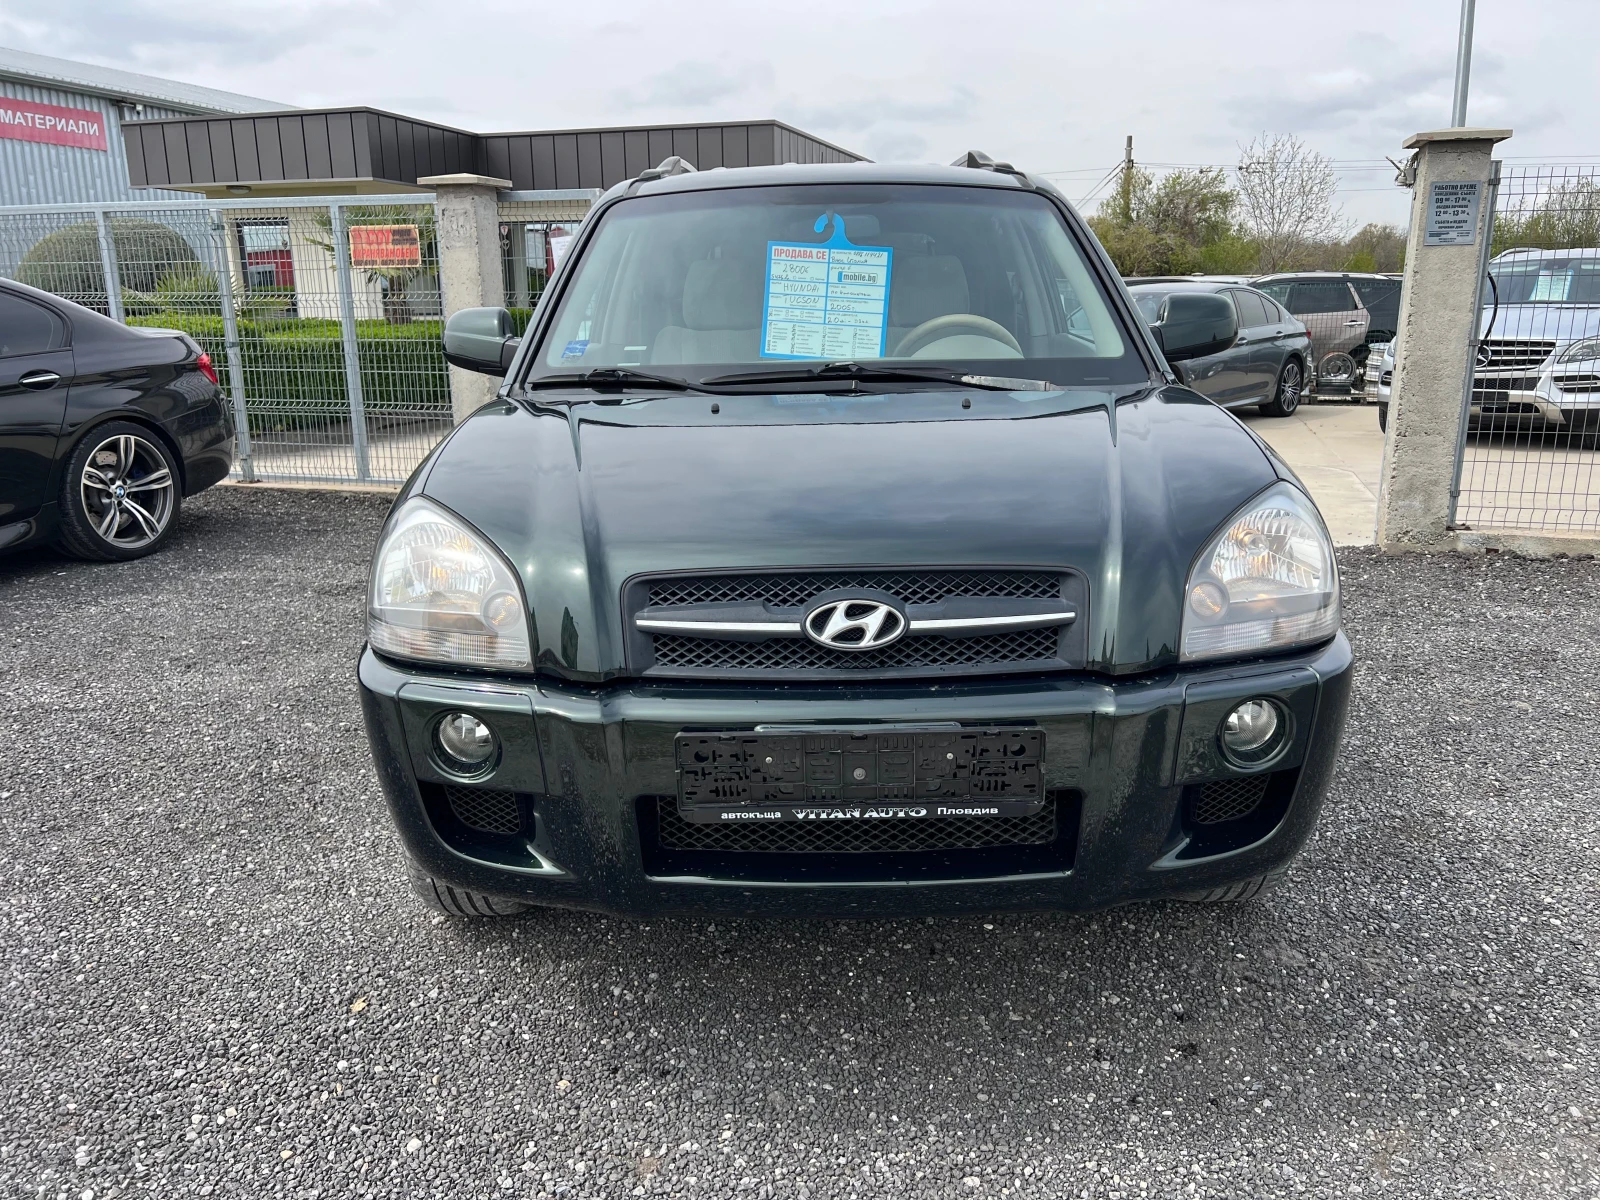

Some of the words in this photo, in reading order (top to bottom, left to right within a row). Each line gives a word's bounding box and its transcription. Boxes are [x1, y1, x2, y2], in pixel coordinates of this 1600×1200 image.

[0, 109, 99, 136] МАТЕРИАЛИ
[366, 230, 391, 245] СОТ
[774, 248, 813, 259] ПРОДАВА
[816, 250, 827, 260] СЕ
[843, 273, 876, 282] mobile.bg
[784, 283, 820, 293] HYUNDAI
[783, 294, 820, 304] TUCSON
[721, 811, 781, 819] автокъща
[792, 808, 861, 819] VITAN
[863, 807, 927, 818] AUTO
[937, 807, 998, 815] Пловдив
